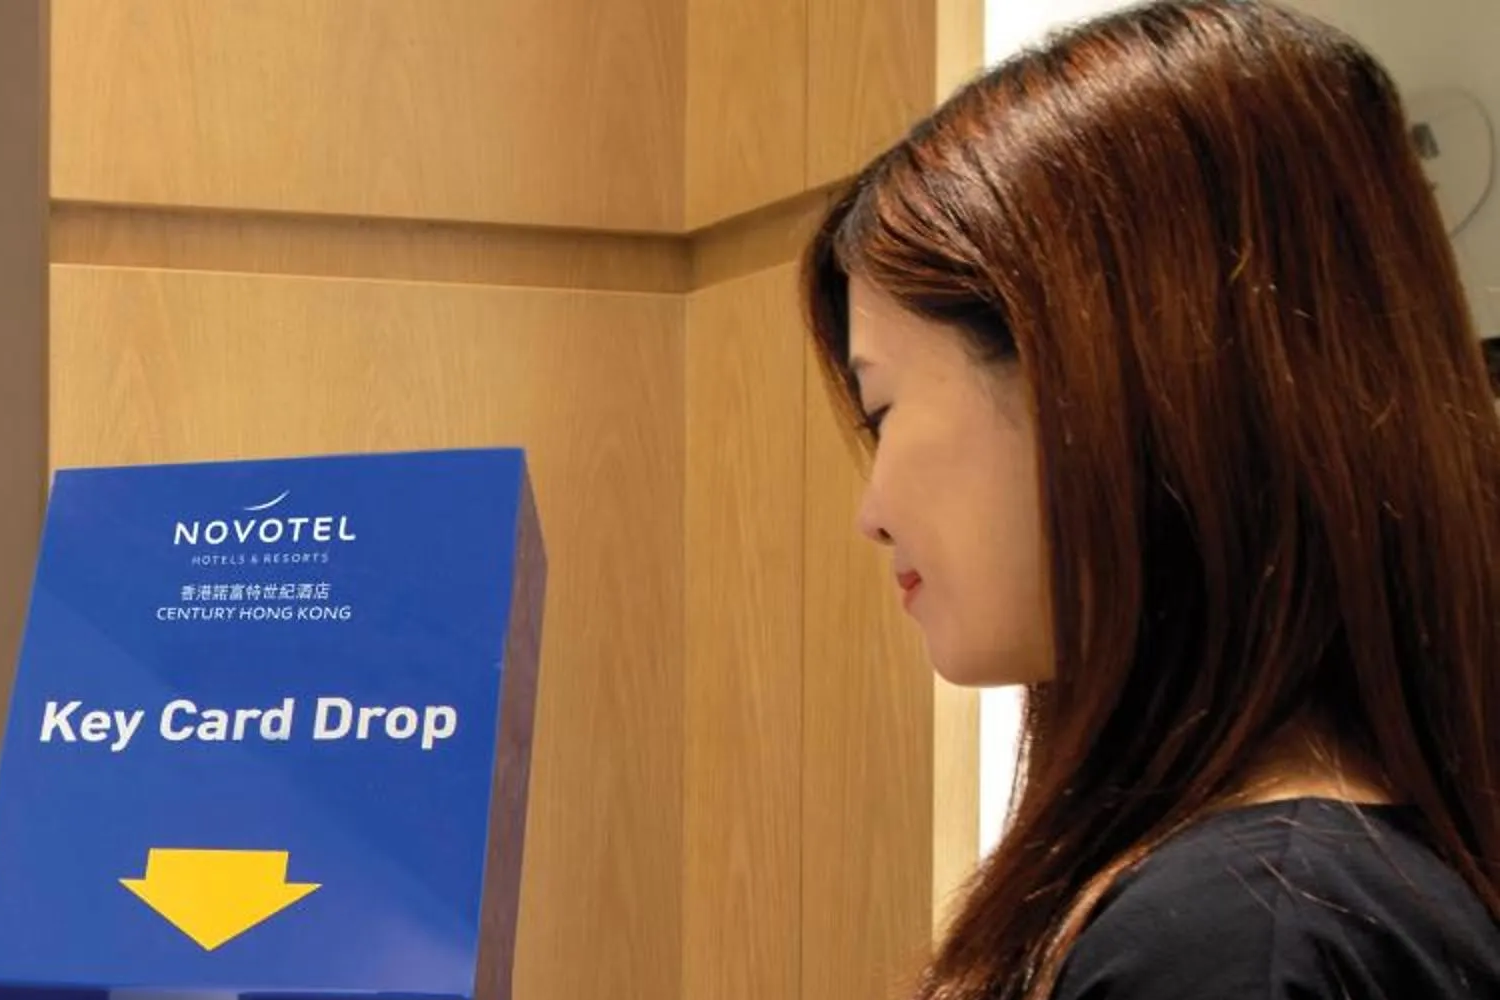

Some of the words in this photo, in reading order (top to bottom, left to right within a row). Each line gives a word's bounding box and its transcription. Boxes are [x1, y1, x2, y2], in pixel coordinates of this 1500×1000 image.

[173, 515, 356, 545] NOVOTEL
[191, 552, 245, 566] HOTELS
[263, 551, 329, 564] RESORTS
[180, 582, 331, 602] 香港諾富特世紀酒店
[156, 606, 236, 621] CENTURY
[239, 606, 293, 620] HONG
[297, 605, 351, 620] KONG
[39, 700, 145, 752] Key
[159, 697, 295, 742] Card
[312, 696, 458, 750] Drop
